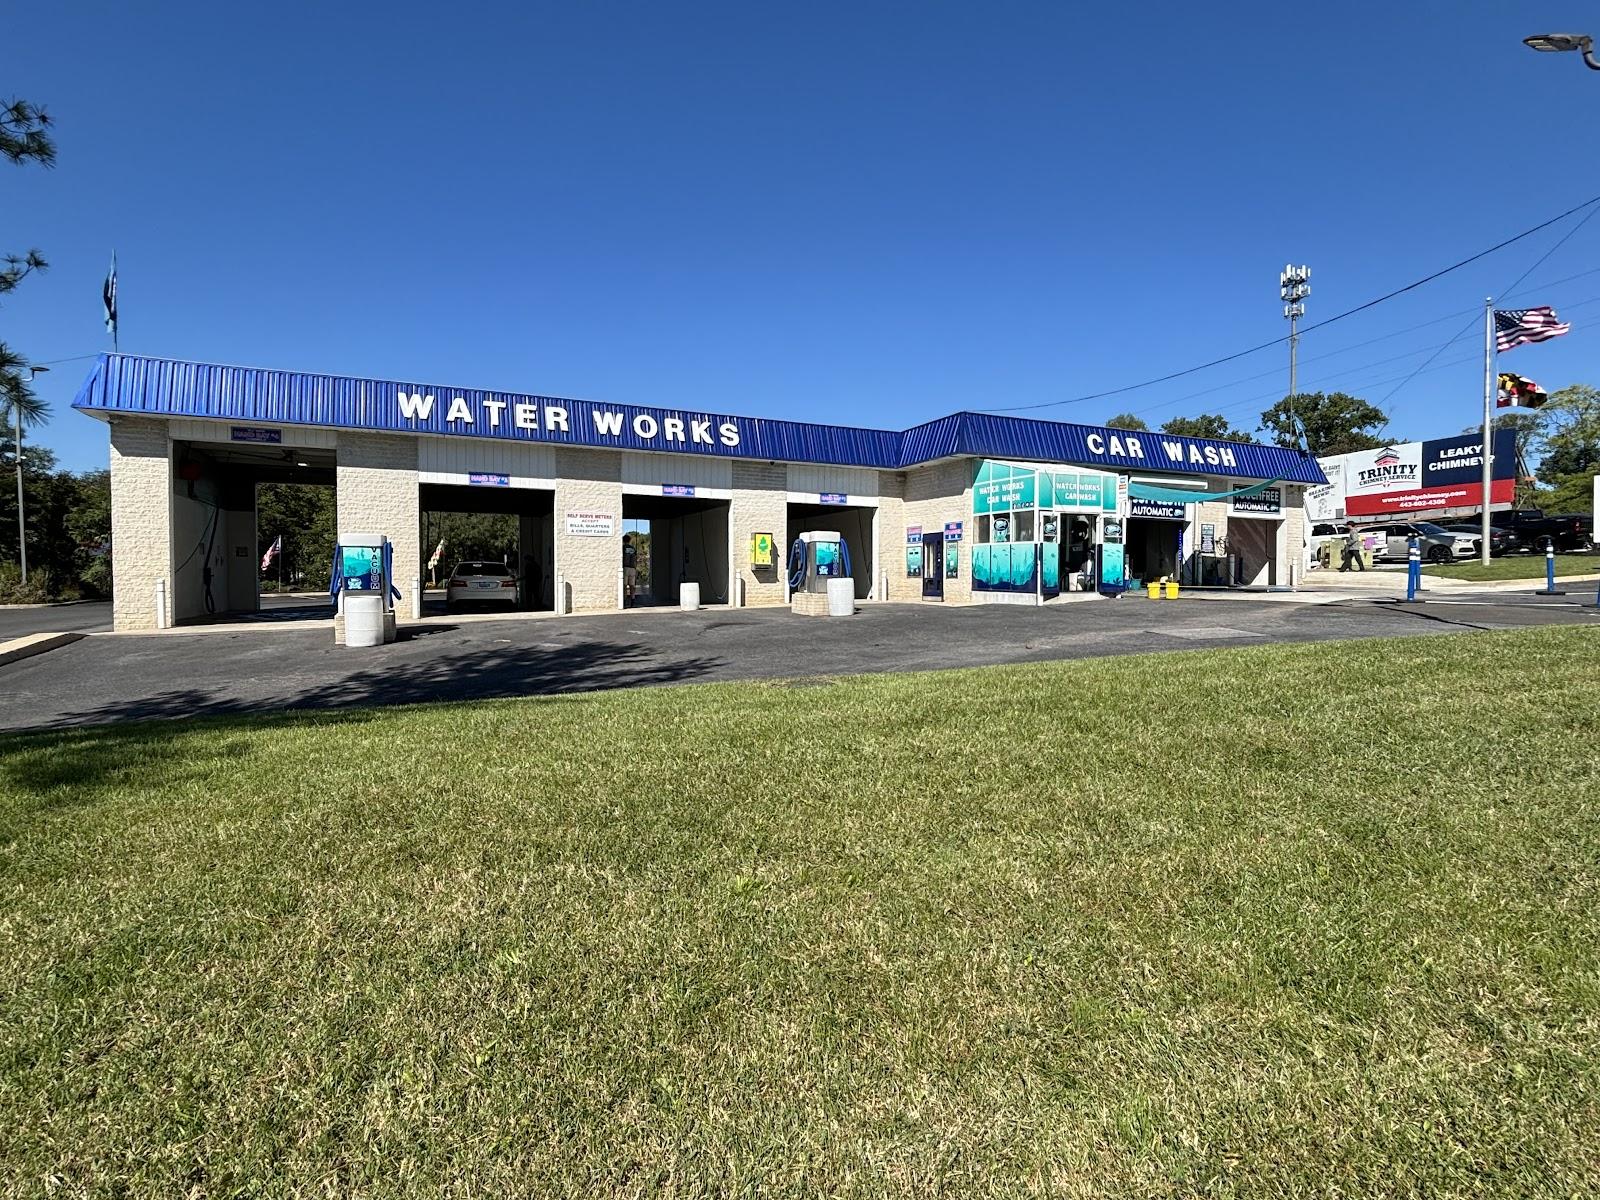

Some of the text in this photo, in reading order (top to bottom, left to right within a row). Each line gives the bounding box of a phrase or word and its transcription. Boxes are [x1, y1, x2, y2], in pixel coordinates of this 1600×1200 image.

[398, 392, 740, 447] WATER WORKS
[1087, 434, 1237, 467] CAR WASH
[1440, 445, 1483, 459] LEAKY
[1358, 464, 1417, 480] TRINITY
[1359, 476, 1387, 485] CHIMNEY
[980, 481, 1024, 495] WATER WORKS
[987, 493, 1021, 504] CAR WASH
[1065, 492, 1077, 500] CAR
[1132, 506, 1174, 517] AUTOMATIC
[1234, 501, 1270, 511] AUTOMATIC
[370, 547, 381, 590] VACUUM
